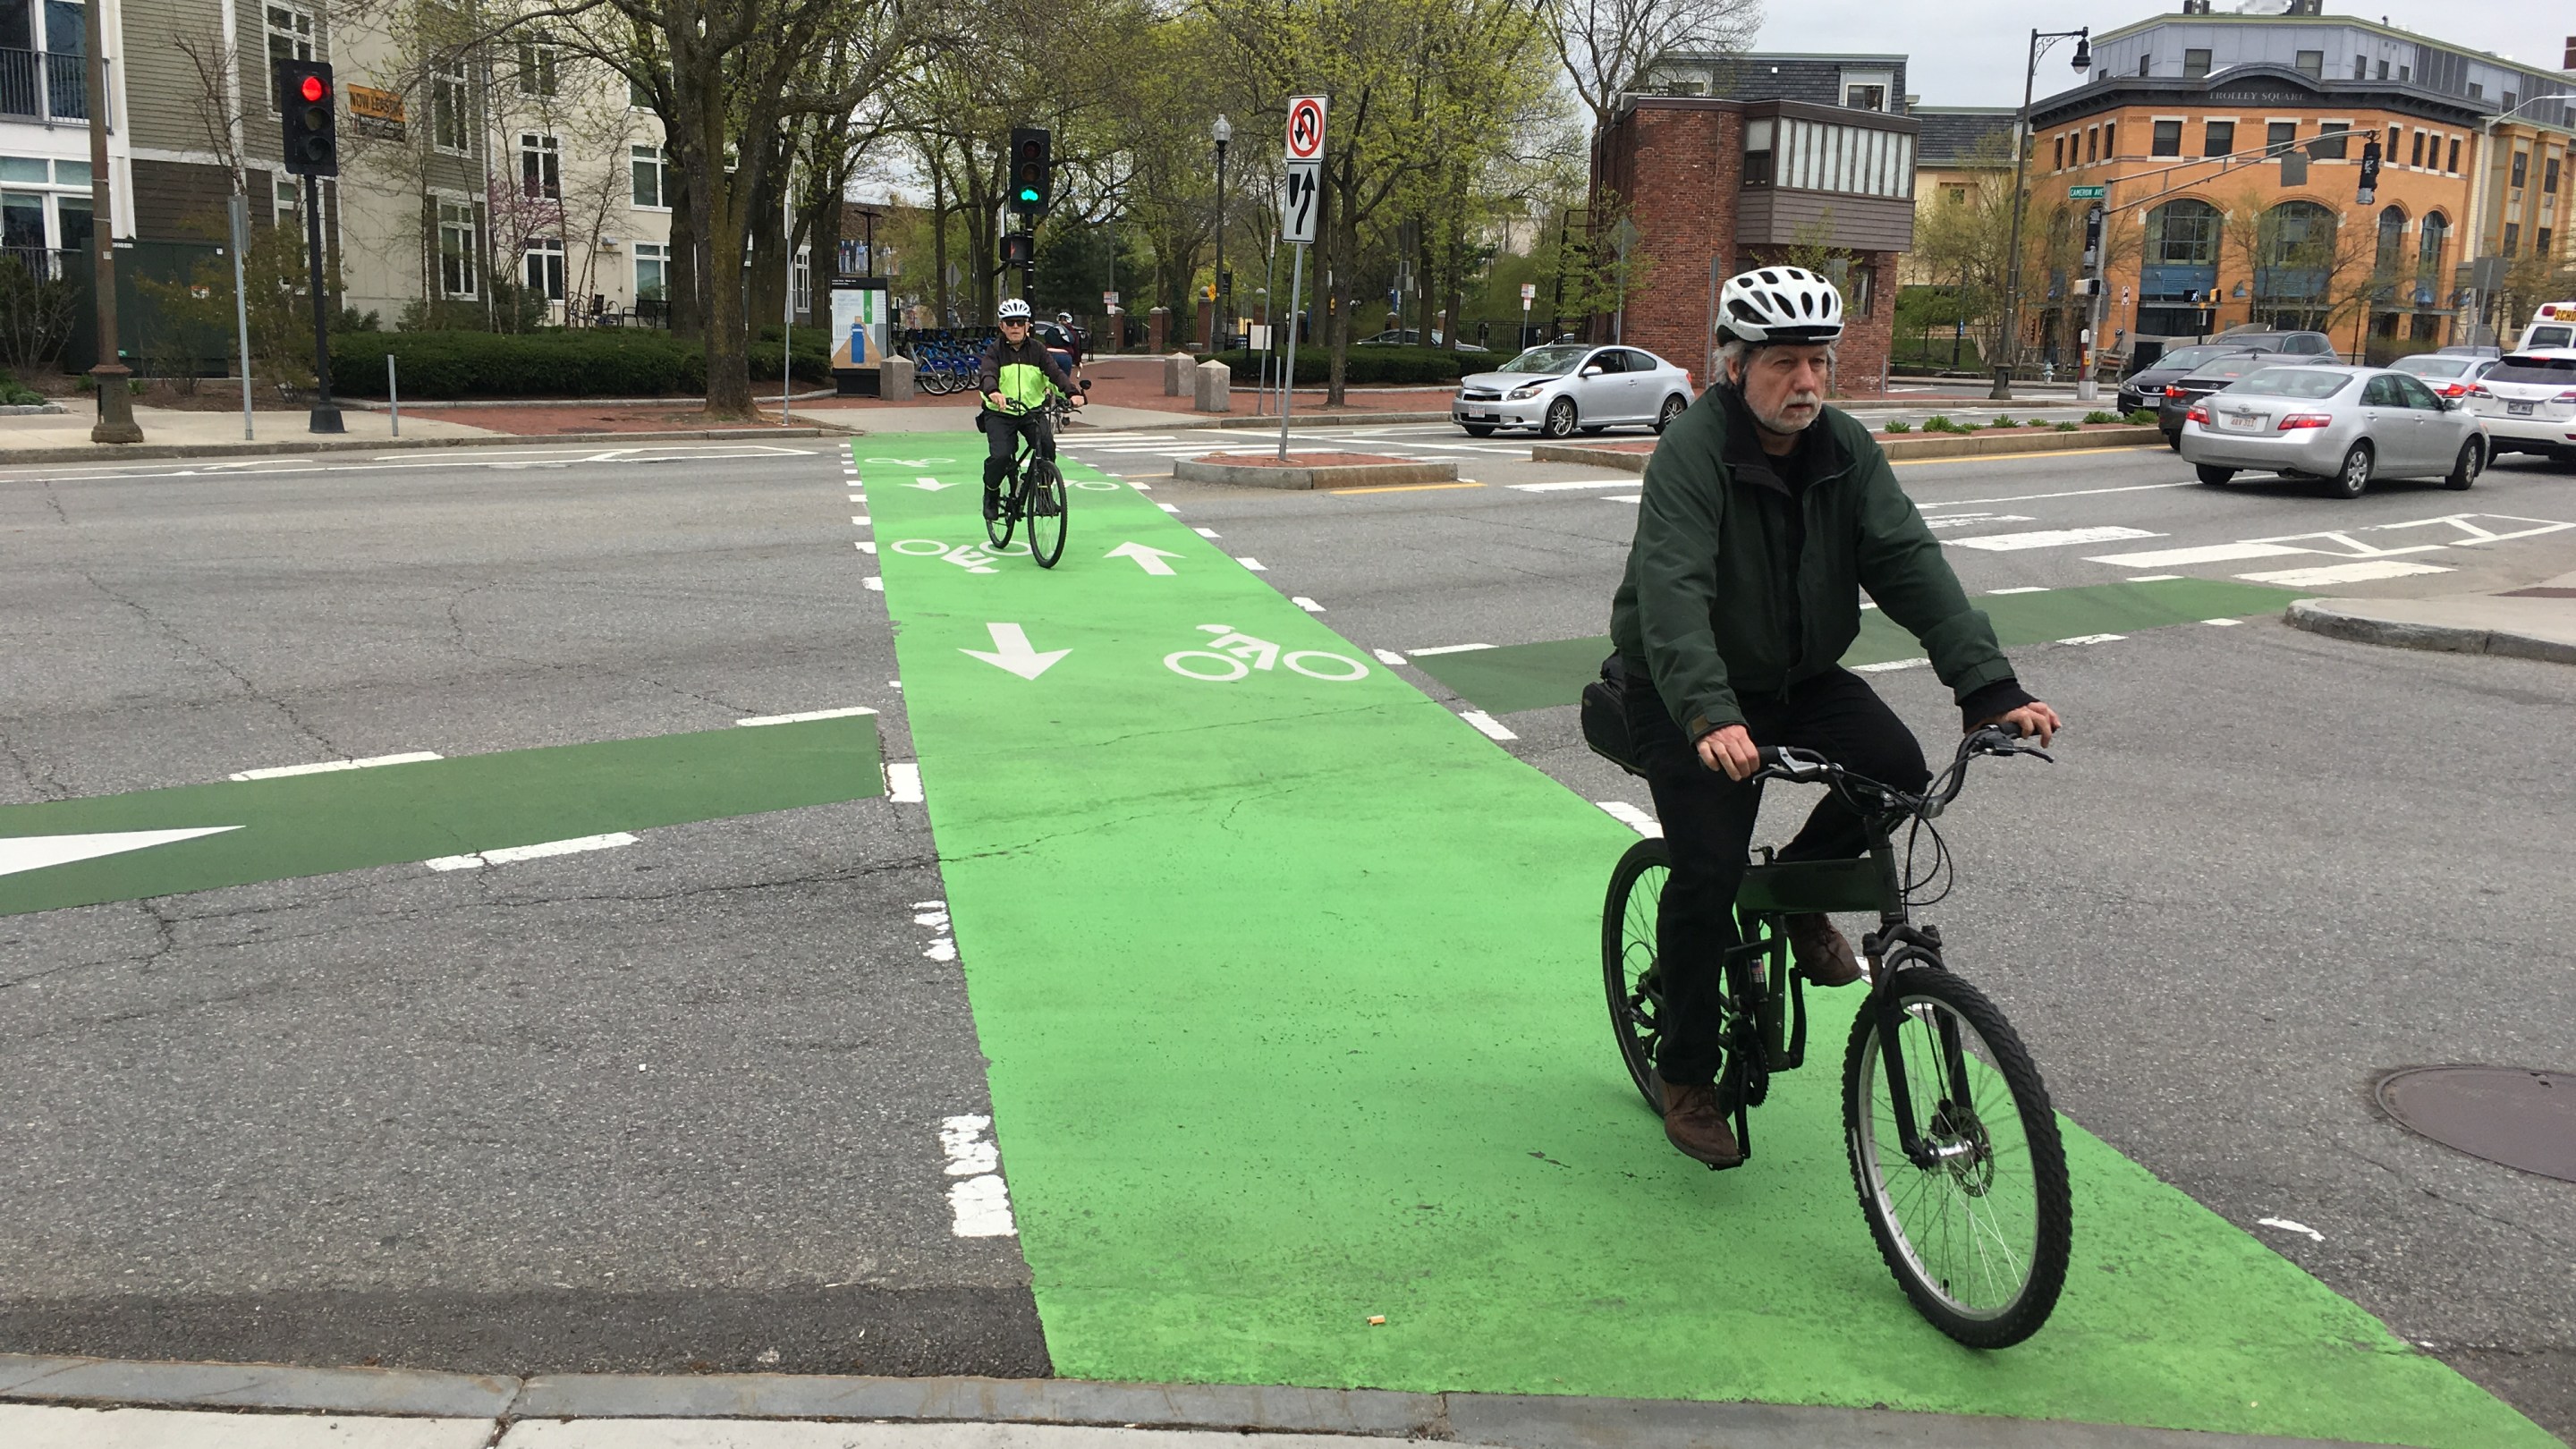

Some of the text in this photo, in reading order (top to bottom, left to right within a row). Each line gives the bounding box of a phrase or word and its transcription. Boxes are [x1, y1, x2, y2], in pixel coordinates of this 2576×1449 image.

[350, 92, 369, 109] NOW
[2209, 91, 2305, 102] TROLLEY SQUARE
